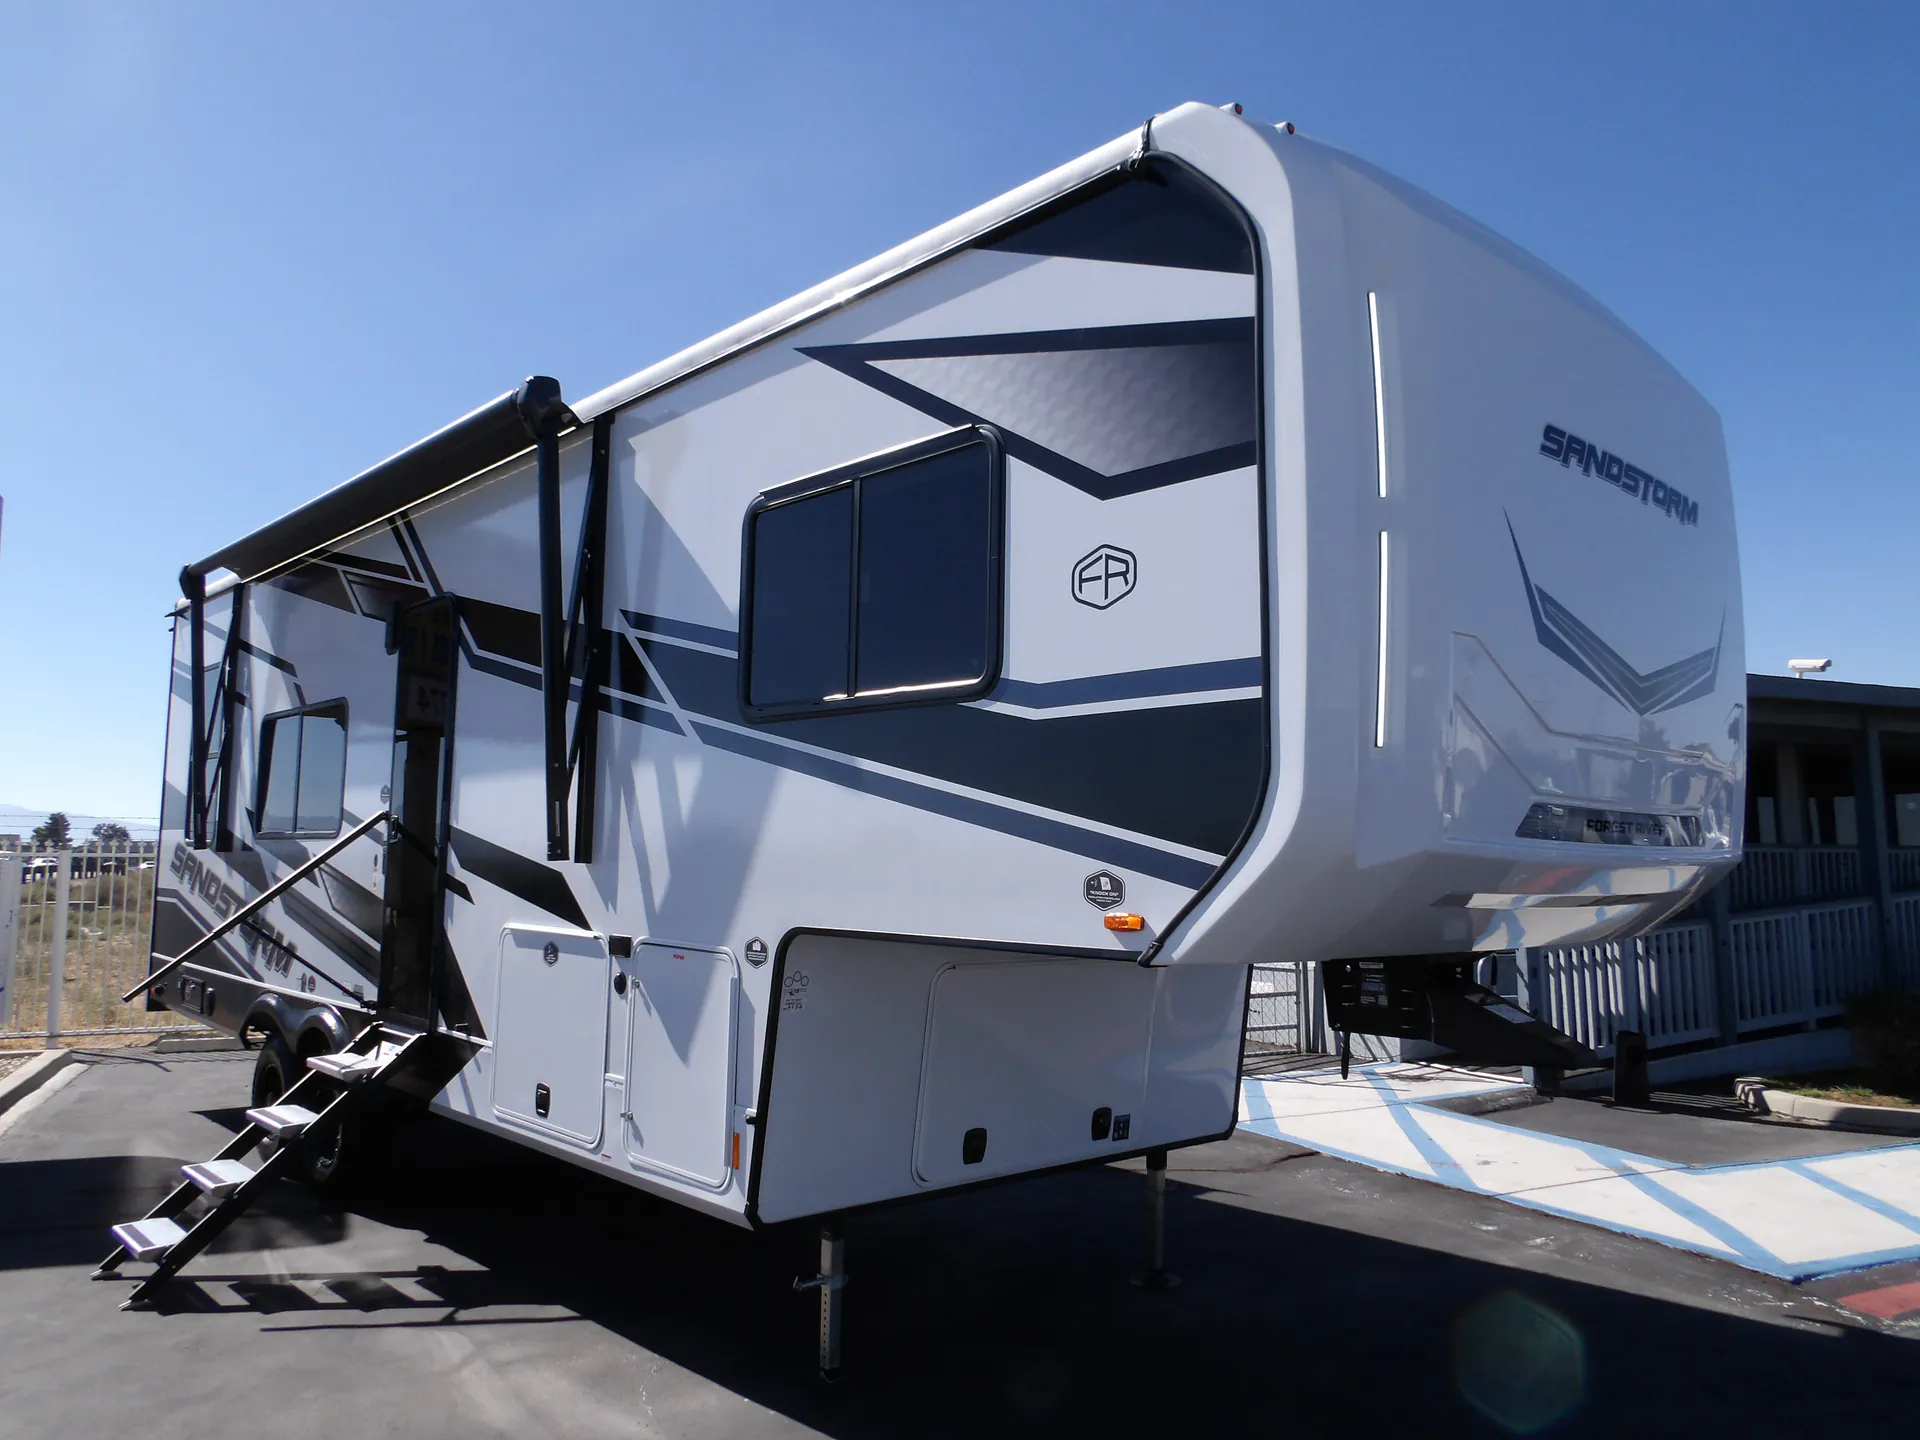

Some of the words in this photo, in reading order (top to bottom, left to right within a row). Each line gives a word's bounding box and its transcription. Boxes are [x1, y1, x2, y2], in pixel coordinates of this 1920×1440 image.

[1539, 423, 1699, 527] SANDSTORM
[1586, 818, 1633, 835] FOREST
[1634, 822, 1664, 836] RIVE
